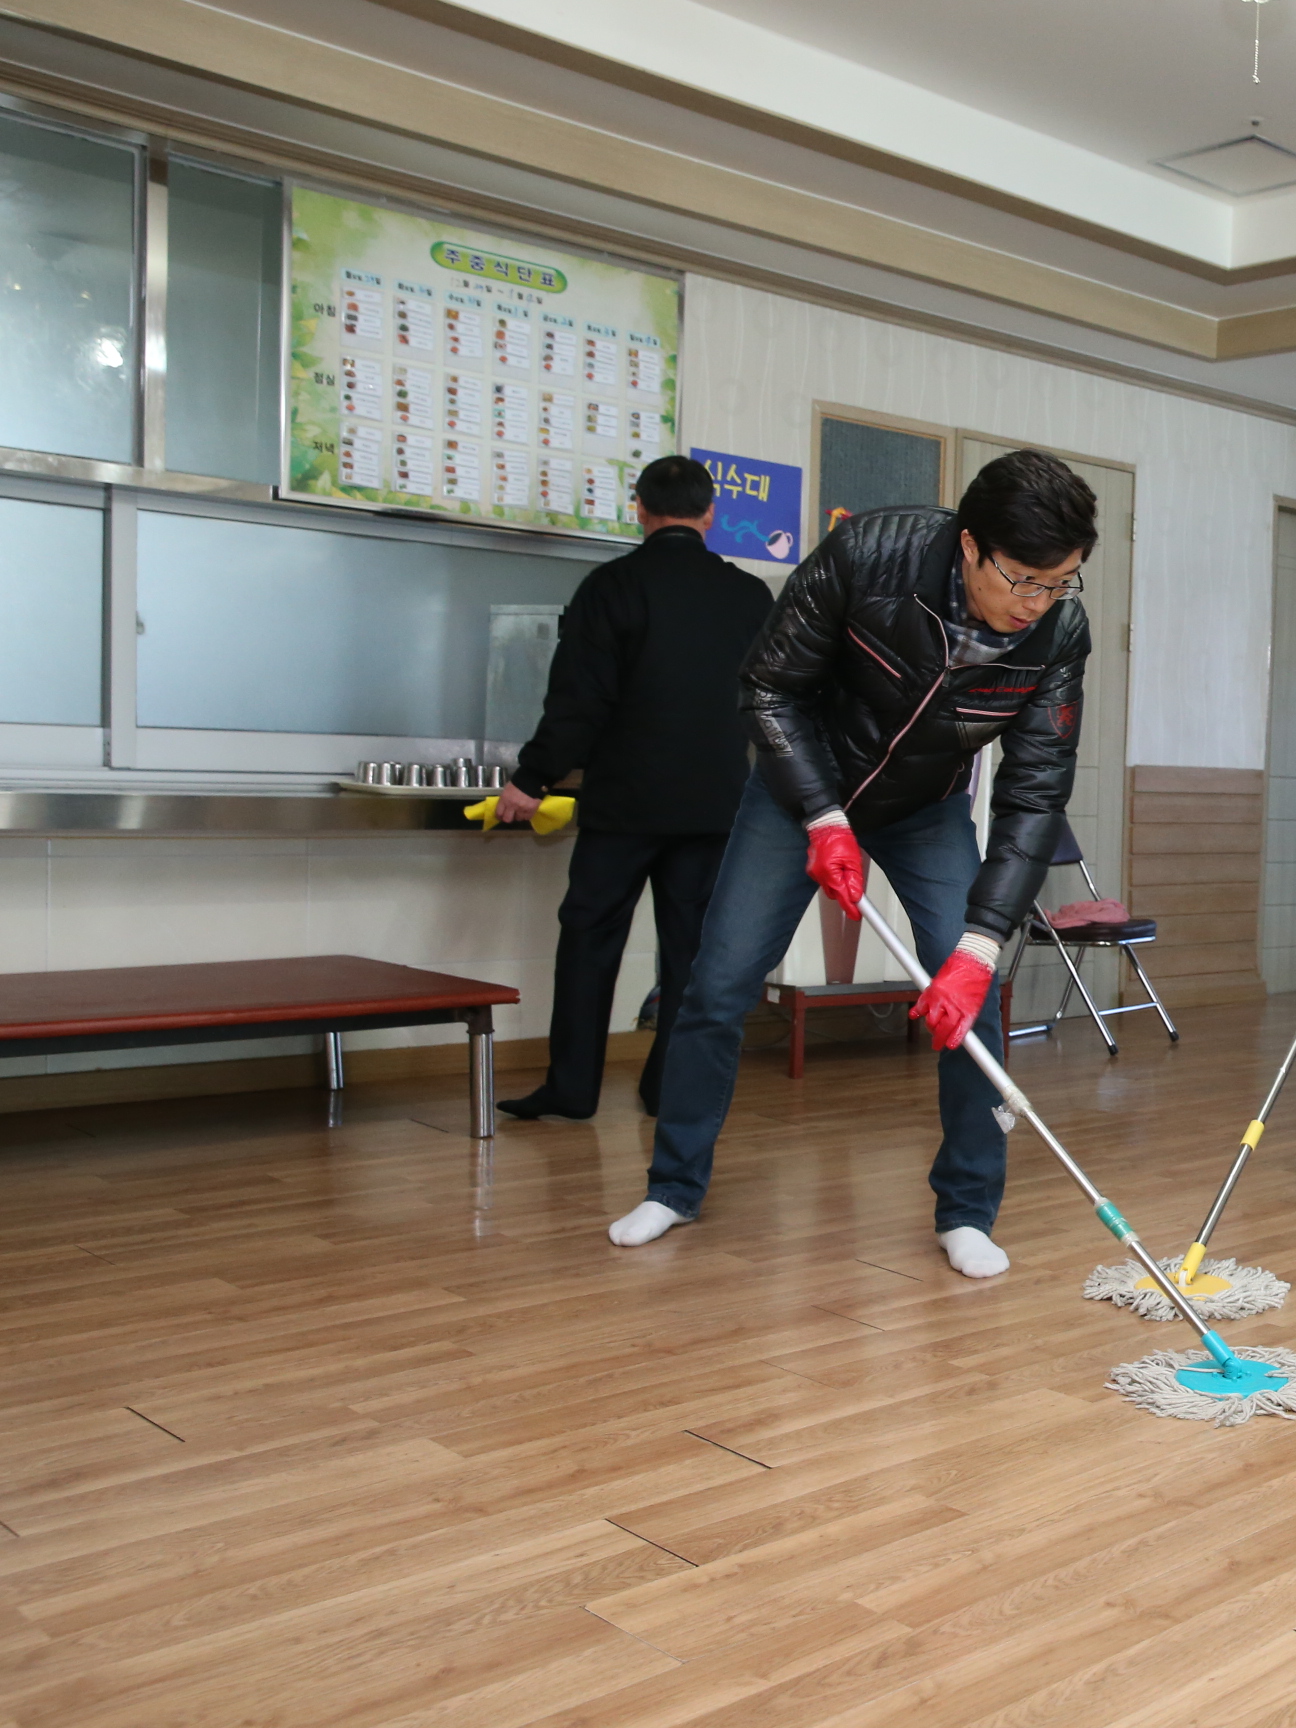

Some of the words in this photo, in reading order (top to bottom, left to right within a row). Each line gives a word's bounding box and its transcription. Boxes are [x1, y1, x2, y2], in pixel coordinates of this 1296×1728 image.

[313, 302, 336, 317] 아침
[313, 371, 336, 387] 점심
[312, 440, 335, 455] 저녁
[703, 459, 770, 502] 식수대
